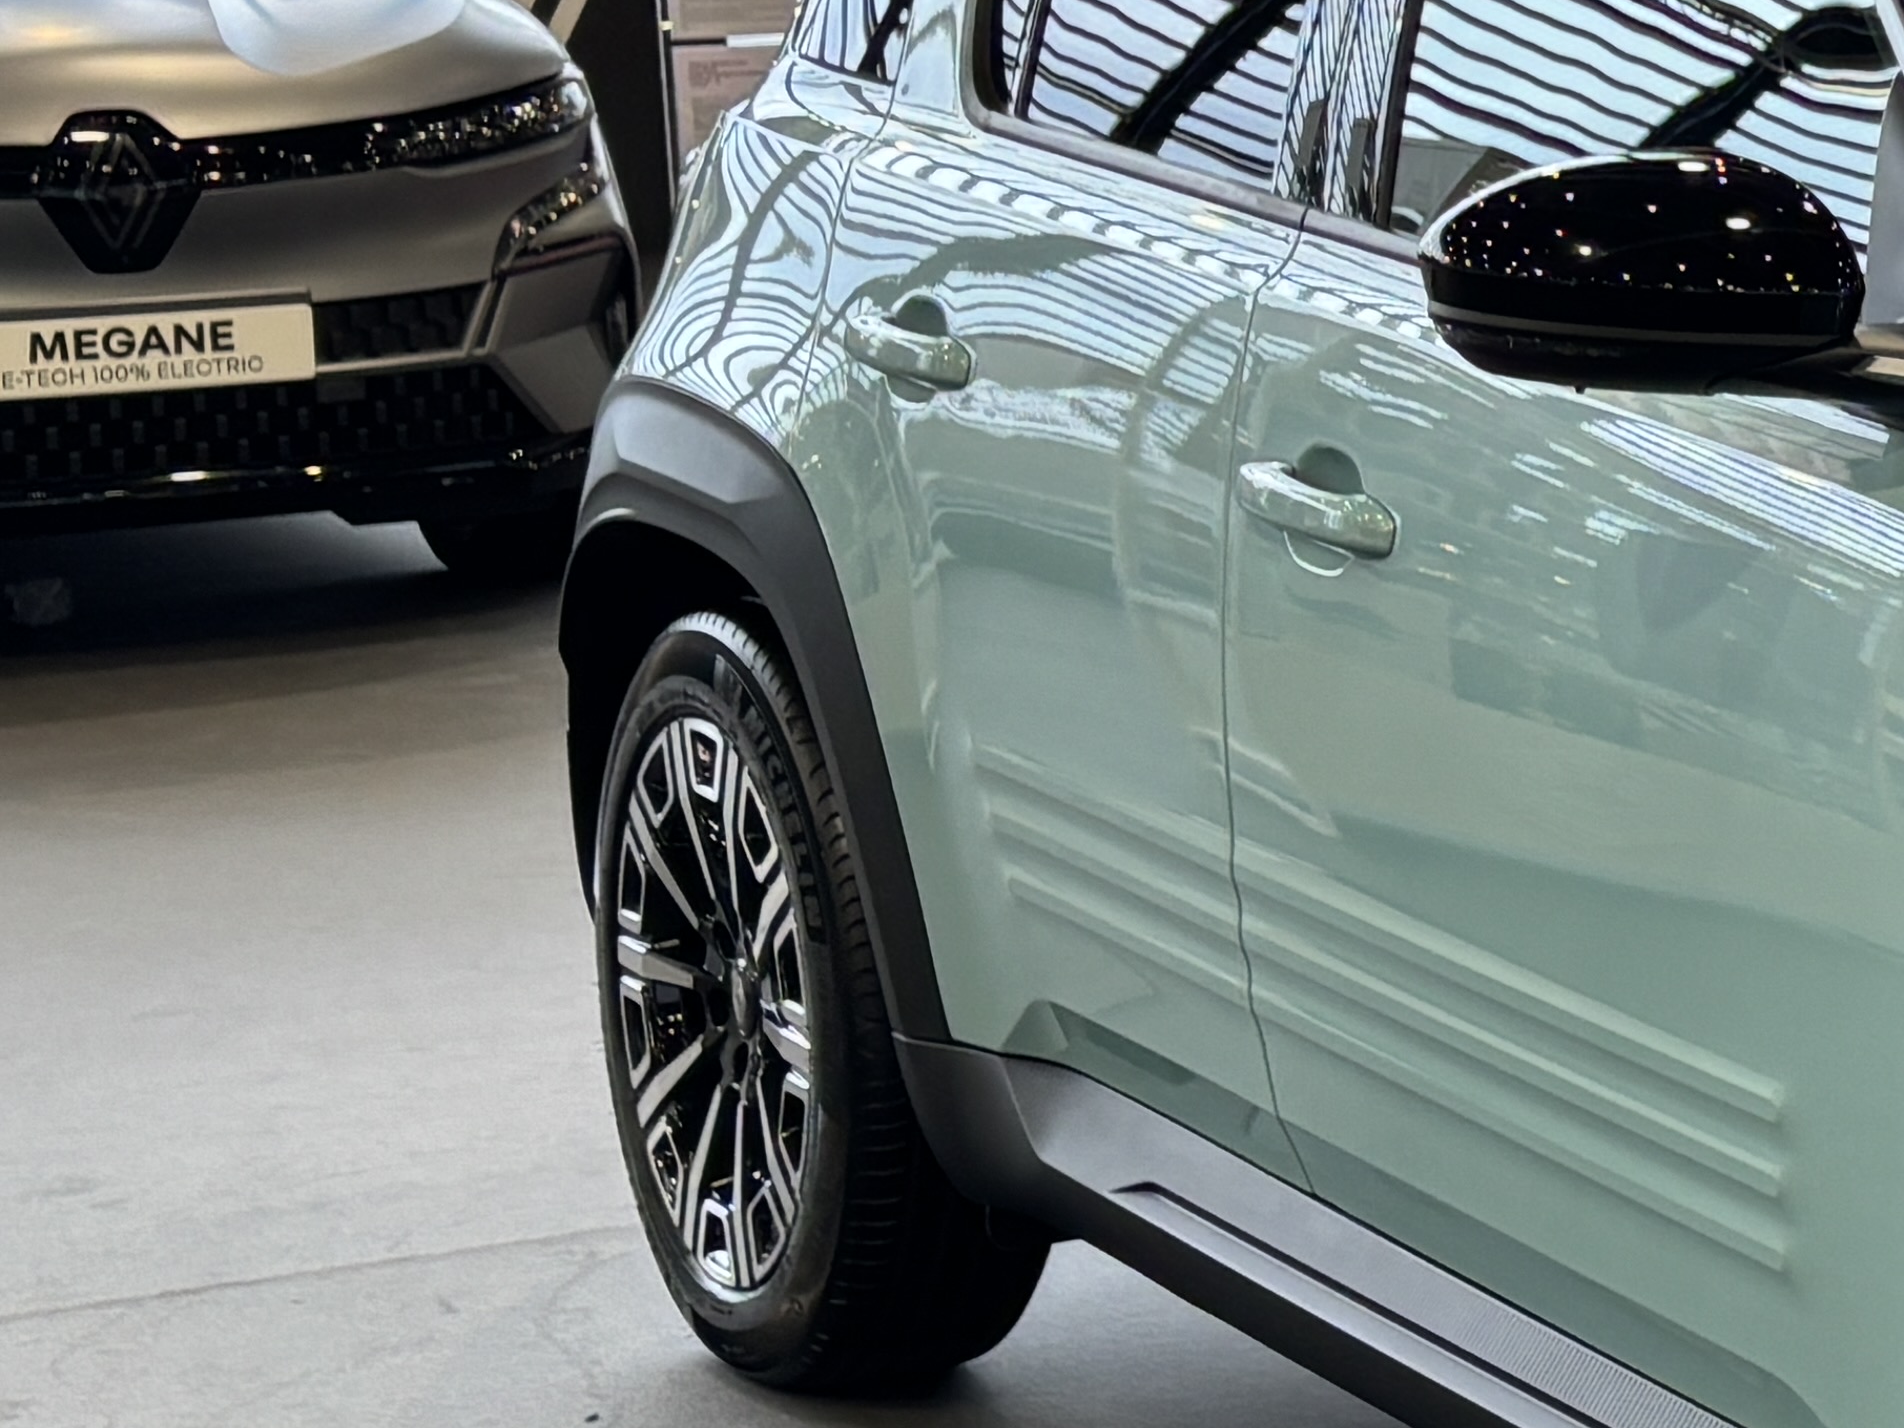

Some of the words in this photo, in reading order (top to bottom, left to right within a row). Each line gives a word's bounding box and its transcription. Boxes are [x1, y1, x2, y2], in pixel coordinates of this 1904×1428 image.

[28, 319, 236, 365] MEGANE
[1, 366, 86, 390] E-TECH
[93, 363, 151, 385] 100%
[156, 355, 266, 381] ELECTRIC
